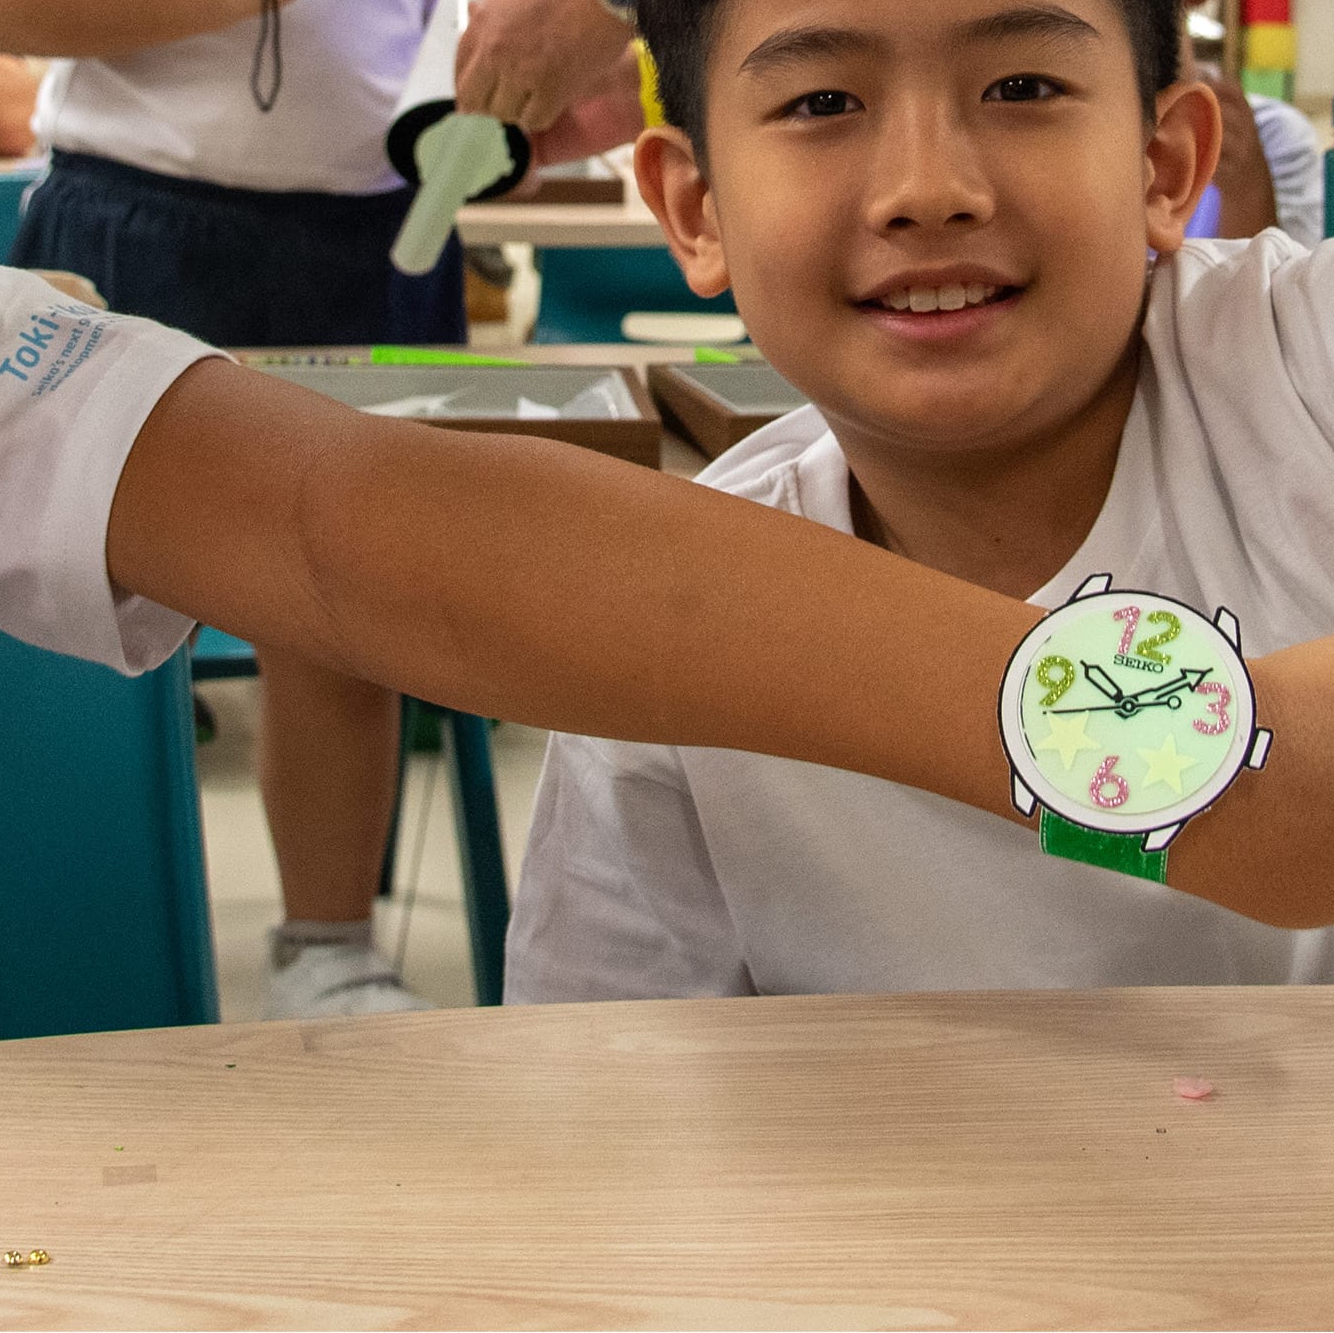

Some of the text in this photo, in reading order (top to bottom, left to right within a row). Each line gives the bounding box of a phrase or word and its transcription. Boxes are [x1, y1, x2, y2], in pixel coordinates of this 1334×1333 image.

[61, 327, 84, 358] next
[1113, 605, 1182, 666] 12
[1036, 654, 1076, 707] 9
[1113, 653, 1165, 675] SEIKO
[1192, 681, 1232, 736] 3
[1088, 754, 1131, 809] 6
